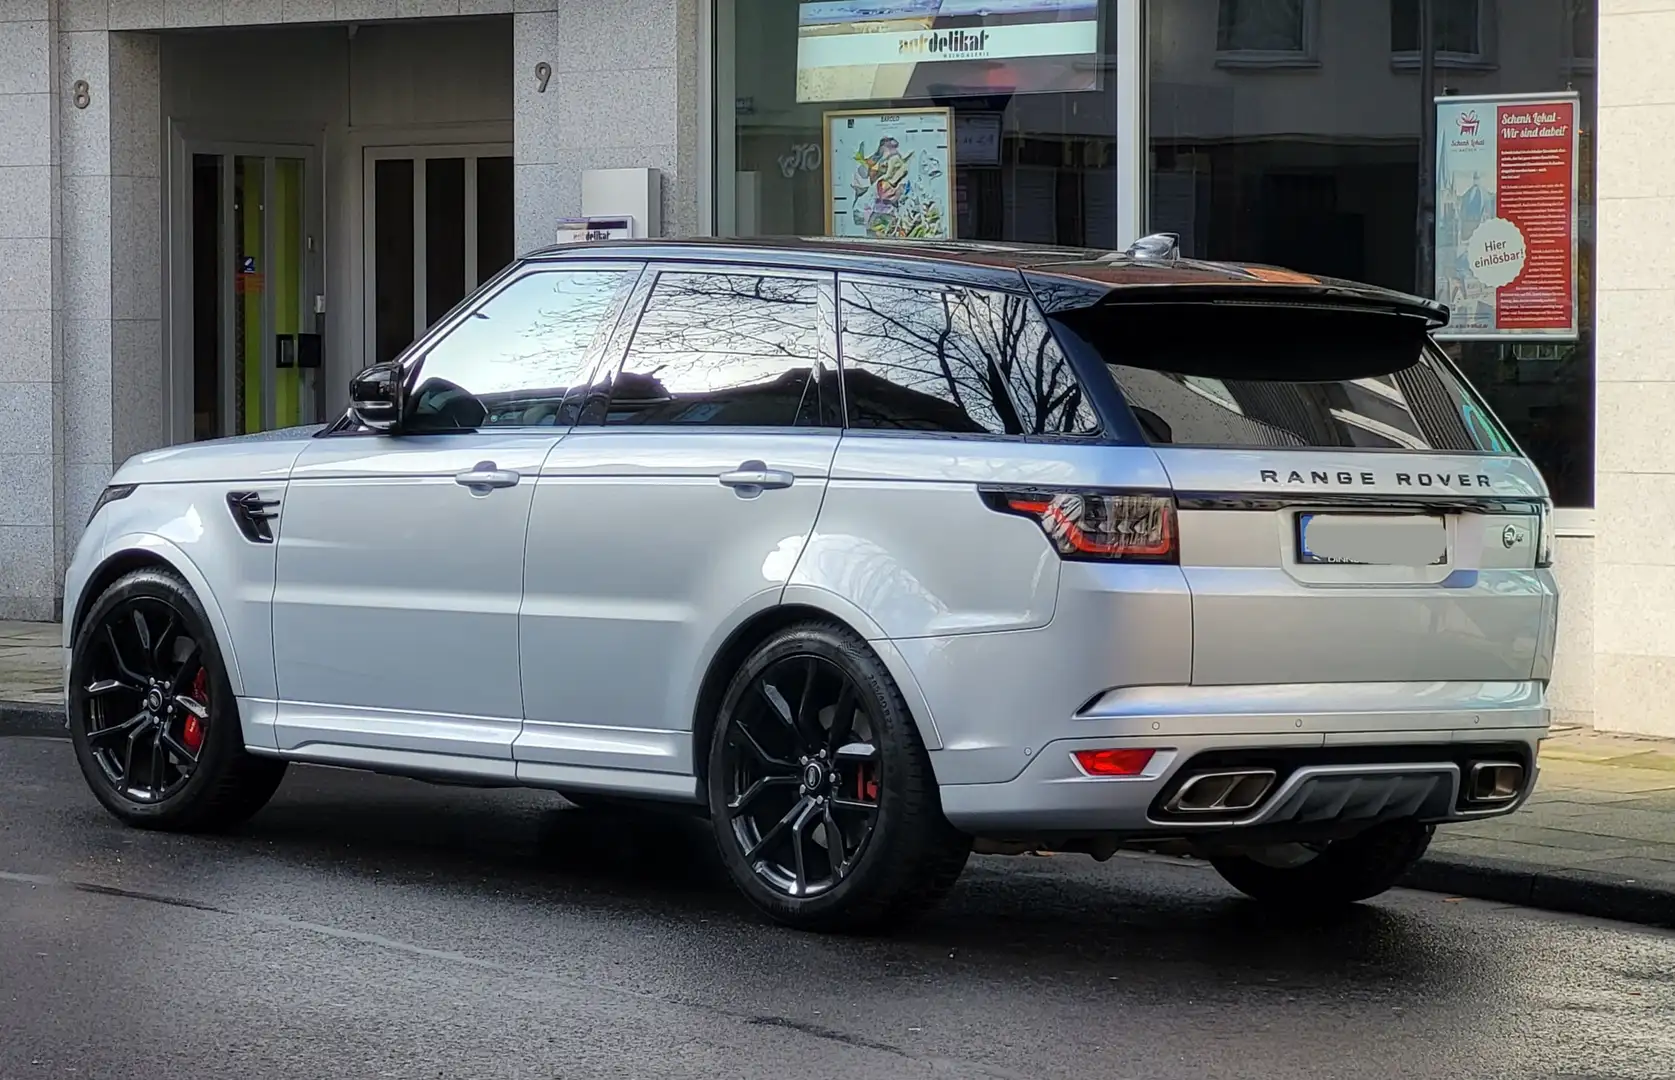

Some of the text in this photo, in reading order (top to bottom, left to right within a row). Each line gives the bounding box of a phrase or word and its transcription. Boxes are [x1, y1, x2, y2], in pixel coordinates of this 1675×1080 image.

[534, 61, 552, 93] 9
[73, 79, 91, 110] 8
[1501, 114, 1532, 125] Schenk
[1533, 111, 1557, 126] Lokal
[1501, 125, 1569, 139] Wir sind dabei!
[1484, 241, 1508, 253] Hier
[1474, 248, 1525, 269] einlösbar!
[1260, 470, 1491, 488] RANGE ROVER
